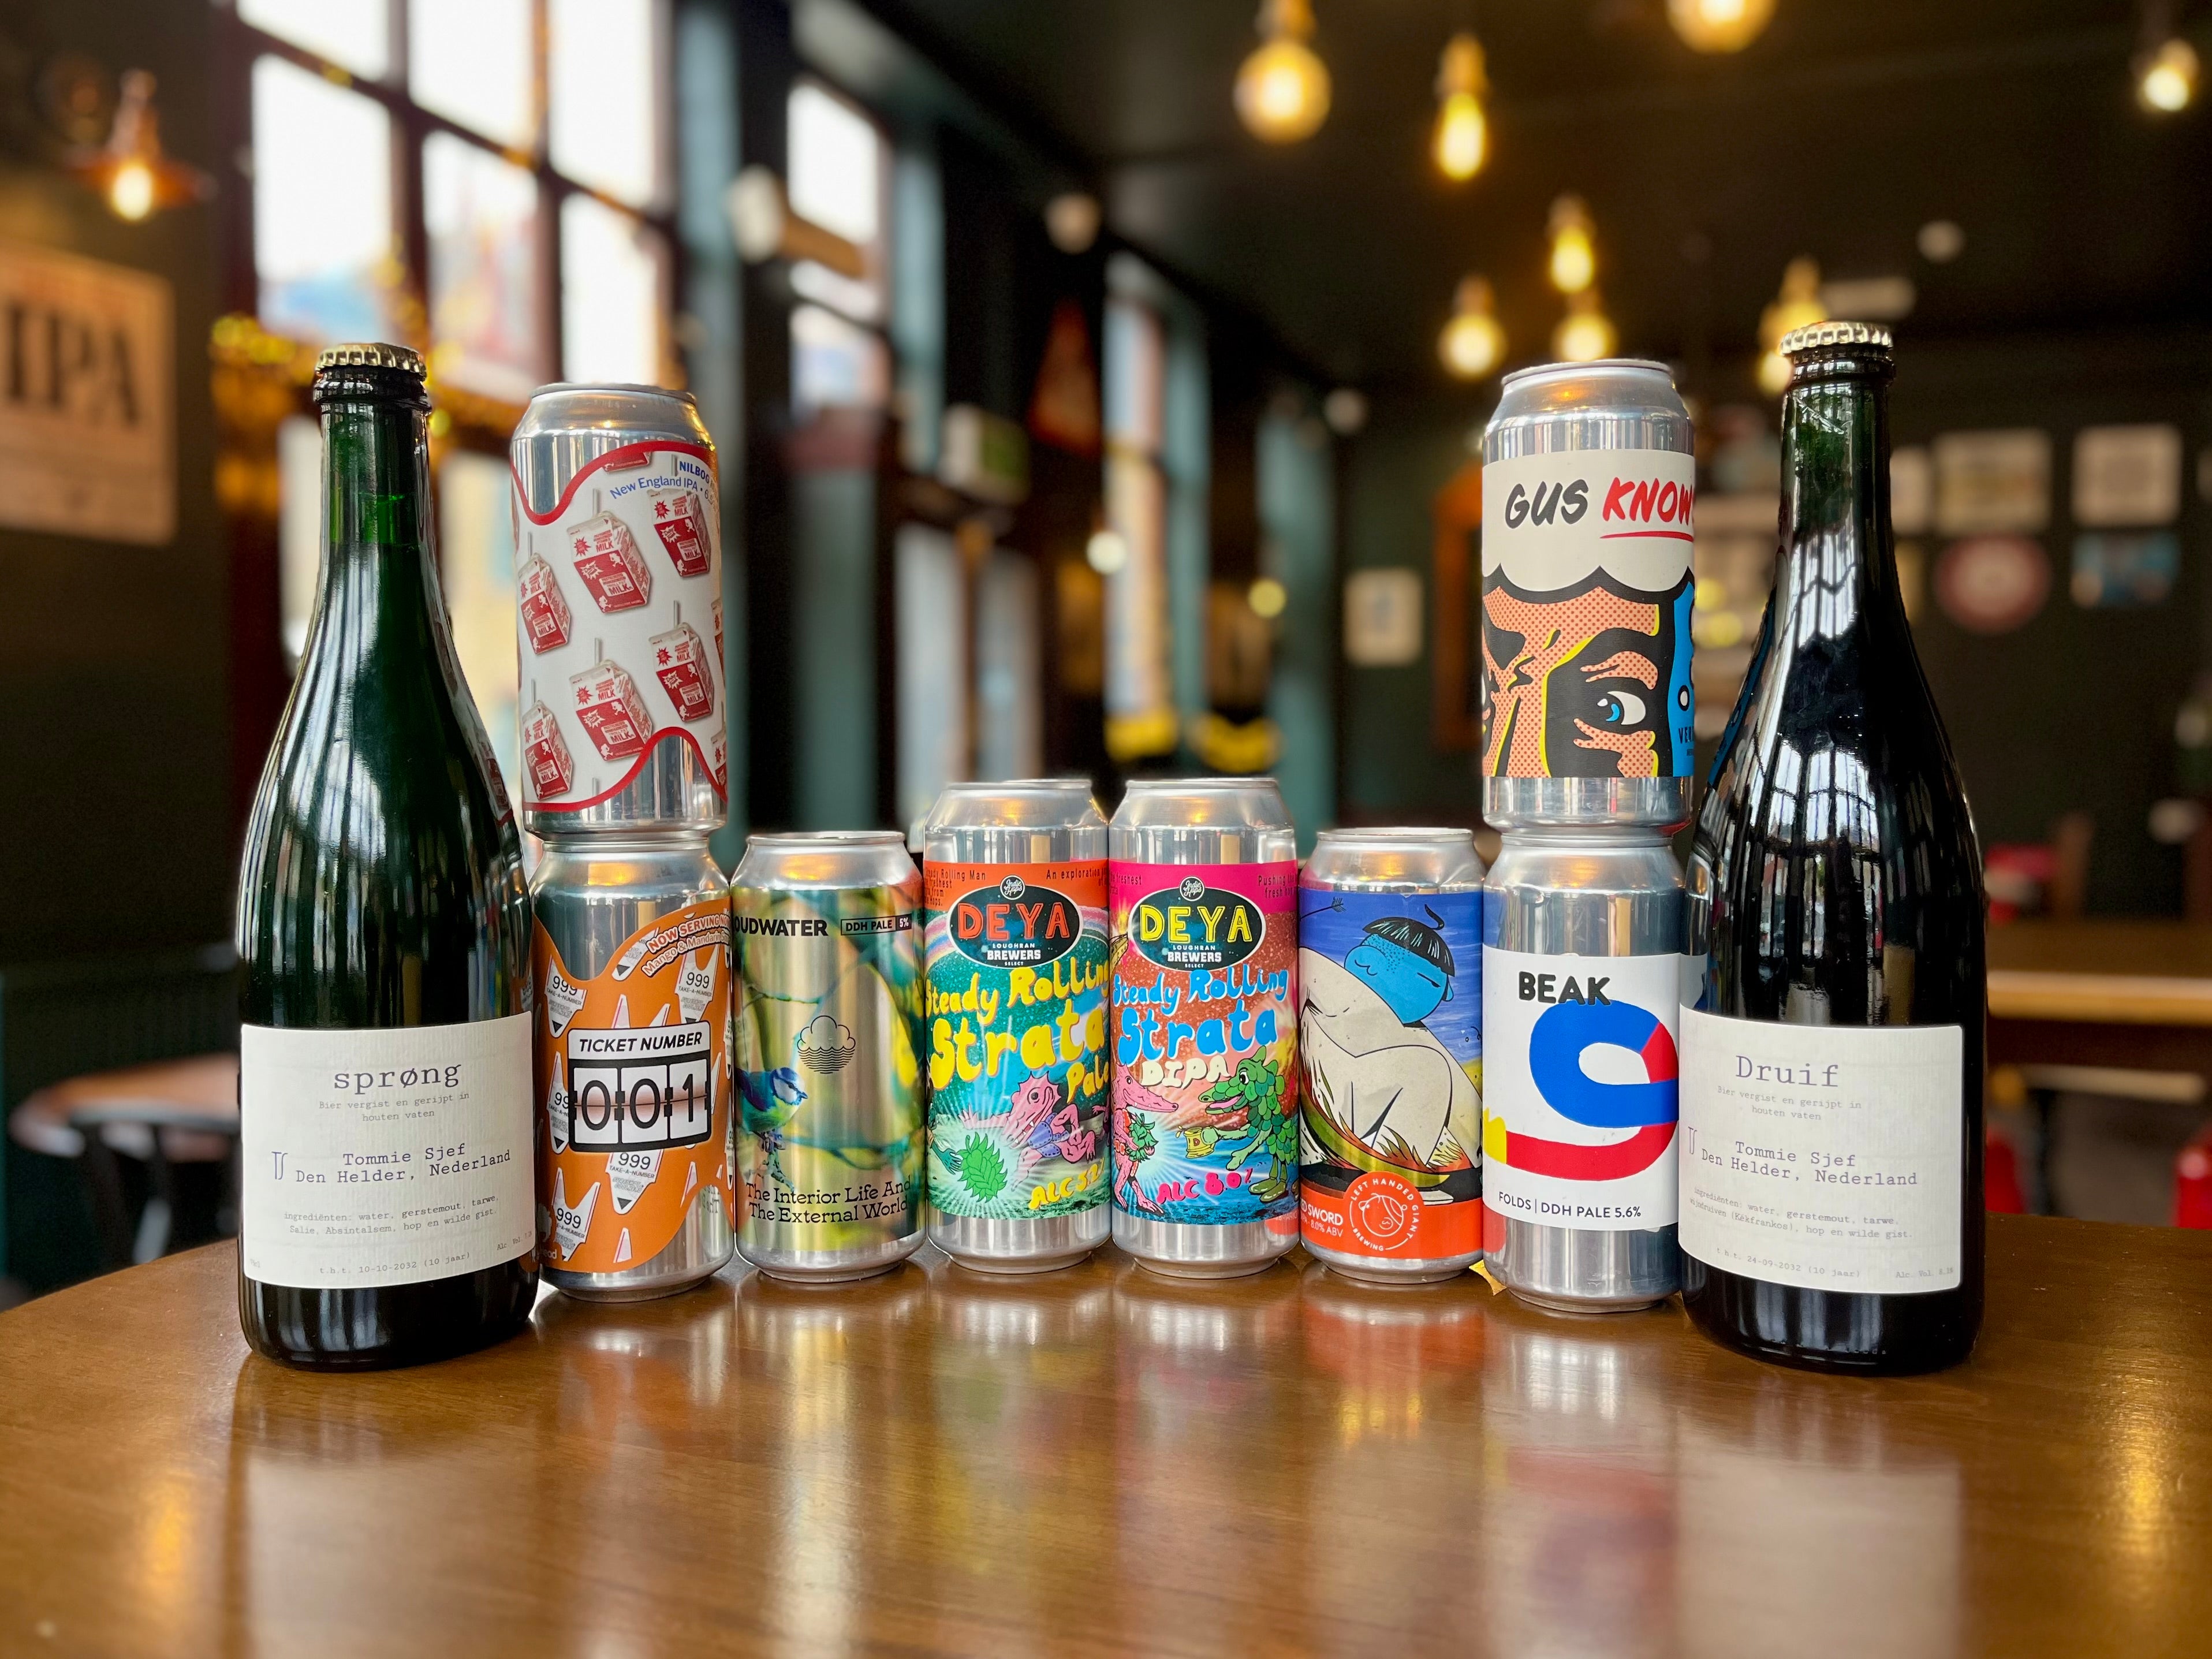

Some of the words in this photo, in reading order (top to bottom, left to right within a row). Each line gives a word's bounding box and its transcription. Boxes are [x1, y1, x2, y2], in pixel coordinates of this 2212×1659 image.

[680, 461, 710, 483] NILBOG
[610, 482, 636, 499] New
[638, 476, 681, 489] England
[684, 478, 697, 491] IPA
[1505, 479, 1588, 529] GUS
[1602, 478, 1694, 523] KNOW
[685, 550, 698, 559] MILK
[609, 584, 629, 595] MILK
[538, 624, 552, 636] MILK
[687, 694, 702, 704] MILK
[611, 732, 631, 743] MILK
[542, 771, 554, 782] MILK
[941, 869, 965, 881] Rolling
[970, 870, 986, 880] Man
[1046, 870, 1056, 879] An
[1061, 867, 1100, 880] exploration
[1258, 874, 1285, 886] Pushing
[1265, 888, 1282, 898] fresh
[648, 929, 677, 951] NOW
[680, 915, 720, 935] SERVING
[846, 922, 867, 931] DDH
[871, 920, 892, 930] PALE
[899, 916, 909, 928] 5%
[957, 902, 1070, 941] DEYA
[1140, 904, 1252, 943] DEYA
[644, 949, 676, 974] Mango
[678, 942, 686, 952] &
[688, 933, 721, 948] Mandarin
[987, 950, 1040, 960] BREWERS
[1167, 952, 1222, 962] BREWERS
[678, 986, 712, 997] TAKE-A-NUMBER
[686, 972, 710, 988] 999
[925, 972, 999, 1025] Steady
[1007, 956, 1109, 1006] Rolling
[1113, 972, 1181, 1016] Steady
[1188, 964, 1289, 1003] Rolling
[1519, 971, 1612, 1006] BEAK
[547, 988, 581, 1005] TAKE-A-NUMBER
[579, 1038, 637, 1052] TICKET
[640, 1032, 703, 1051] NUMBER
[1118, 998, 1278, 1067] Strata
[931, 999, 1105, 1090] Strata
[334, 1064, 462, 1095] sprøng
[1067, 1055, 1109, 1103] Pale
[1142, 1055, 1233, 1090] DIPA
[1736, 1055, 1840, 1088] Druif
[319, 1101, 342, 1109] Bier
[348, 1099, 390, 1110] vergist
[414, 1093, 454, 1106] gerijpt
[459, 1092, 469, 1100] in
[1717, 1086, 1736, 1097] Bier
[1740, 1091, 1776, 1102] vergist
[1782, 1097, 1795, 1105] en
[1800, 1098, 1843, 1110] gerijpt
[1849, 1101, 1862, 1109] in
[362, 1113, 399, 1121] houten
[405, 1110, 435, 1119] vaten
[1751, 1105, 1785, 1117] houten
[1791, 1110, 1822, 1120] vaten
[343, 1151, 412, 1166] Tommie
[425, 1143, 466, 1161] Sjef
[618, 1152, 651, 1169] 999
[1735, 1141, 1797, 1162] Tommie
[1811, 1152, 1856, 1168] Sjef
[296, 1170, 326, 1183] Den
[337, 1169, 415, 1184] Helder,
[429, 1149, 511, 1176] Nederland
[610, 1165, 655, 1178] TAKE-A-NUMBER
[1702, 1148, 1723, 1166] Den
[1731, 1157, 1801, 1181] Helder,
[1815, 1169, 1918, 1185] Nederland
[745, 1183, 770, 1201] The
[774, 1188, 841, 1204] Interior
[845, 1186, 879, 1203] Life
[882, 1175, 911, 1198] And
[1028, 1177, 1073, 1210] ALC
[1157, 1180, 1199, 1205] ALC
[749, 1202, 775, 1221] The
[778, 1205, 858, 1224] External
[862, 1195, 908, 1220] World
[1308, 1204, 1343, 1225] SWORD
[1350, 1182, 1369, 1201] LEFT
[1372, 1178, 1415, 1201] HANDED
[1407, 1205, 1419, 1239] GIANT
[1499, 1192, 1532, 1210] FOLDS
[1541, 1202, 1571, 1217] DDH
[1577, 1206, 1611, 1218] PALE
[1614, 1206, 1641, 1218] 5.6%
[403, 1221, 421, 1232] hop
[427, 1219, 439, 1228] en
[444, 1212, 471, 1225] wilde
[475, 1209, 497, 1219] gist.
[556, 1208, 581, 1229] 999
[1311, 1220, 1325, 1232] 8.0%
[1326, 1226, 1343, 1237] ABV
[1352, 1228, 1385, 1252] BREWING
[1806, 1225, 1825, 1236] hop
[1848, 1229, 1880, 1238] wilde
[1885, 1230, 1913, 1239] gist.
[359, 1261, 417, 1274] 10-10-2032
[424, 1257, 440, 1268] (10
[445, 1251, 470, 1265] jaar)
[1747, 1255, 1801, 1273] 24-09-2032
[1808, 1265, 1825, 1275] (10
[1831, 1269, 1860, 1278] jaar)
